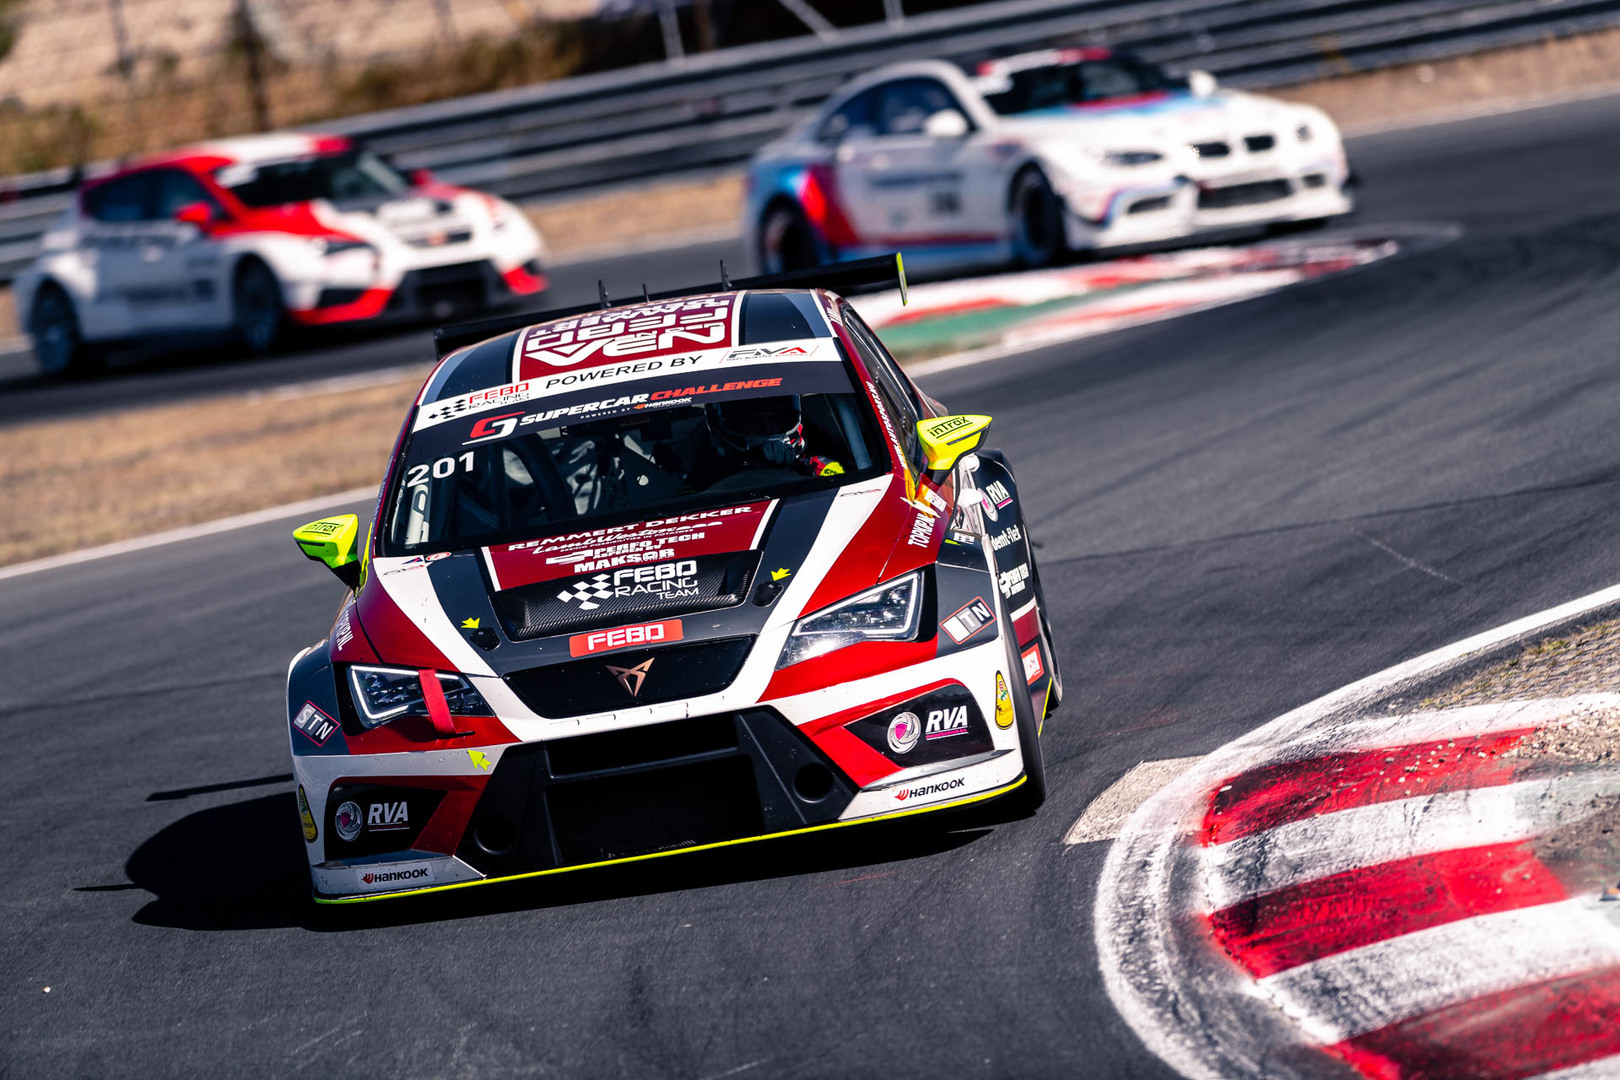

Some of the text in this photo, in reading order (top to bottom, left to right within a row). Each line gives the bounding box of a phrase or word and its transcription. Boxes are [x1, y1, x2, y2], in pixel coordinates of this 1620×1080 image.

[545, 354, 704, 390] POWERED BY
[468, 393, 529, 409] RACING
[469, 382, 530, 405] FEBO
[519, 377, 784, 426] SUPERCAR CHALLENGE
[580, 409, 618, 420] POWERED
[407, 451, 475, 488] 201
[985, 480, 1010, 504] RVA
[508, 506, 752, 552] REMMERT DEKKER
[655, 532, 705, 547] TECH
[614, 559, 697, 587] FEBO
[615, 577, 698, 598] RACING
[656, 587, 700, 600] TEAM
[588, 624, 665, 651] FEBO
[297, 708, 334, 741] STN
[925, 705, 968, 733] RVA
[367, 801, 409, 824] RVA
